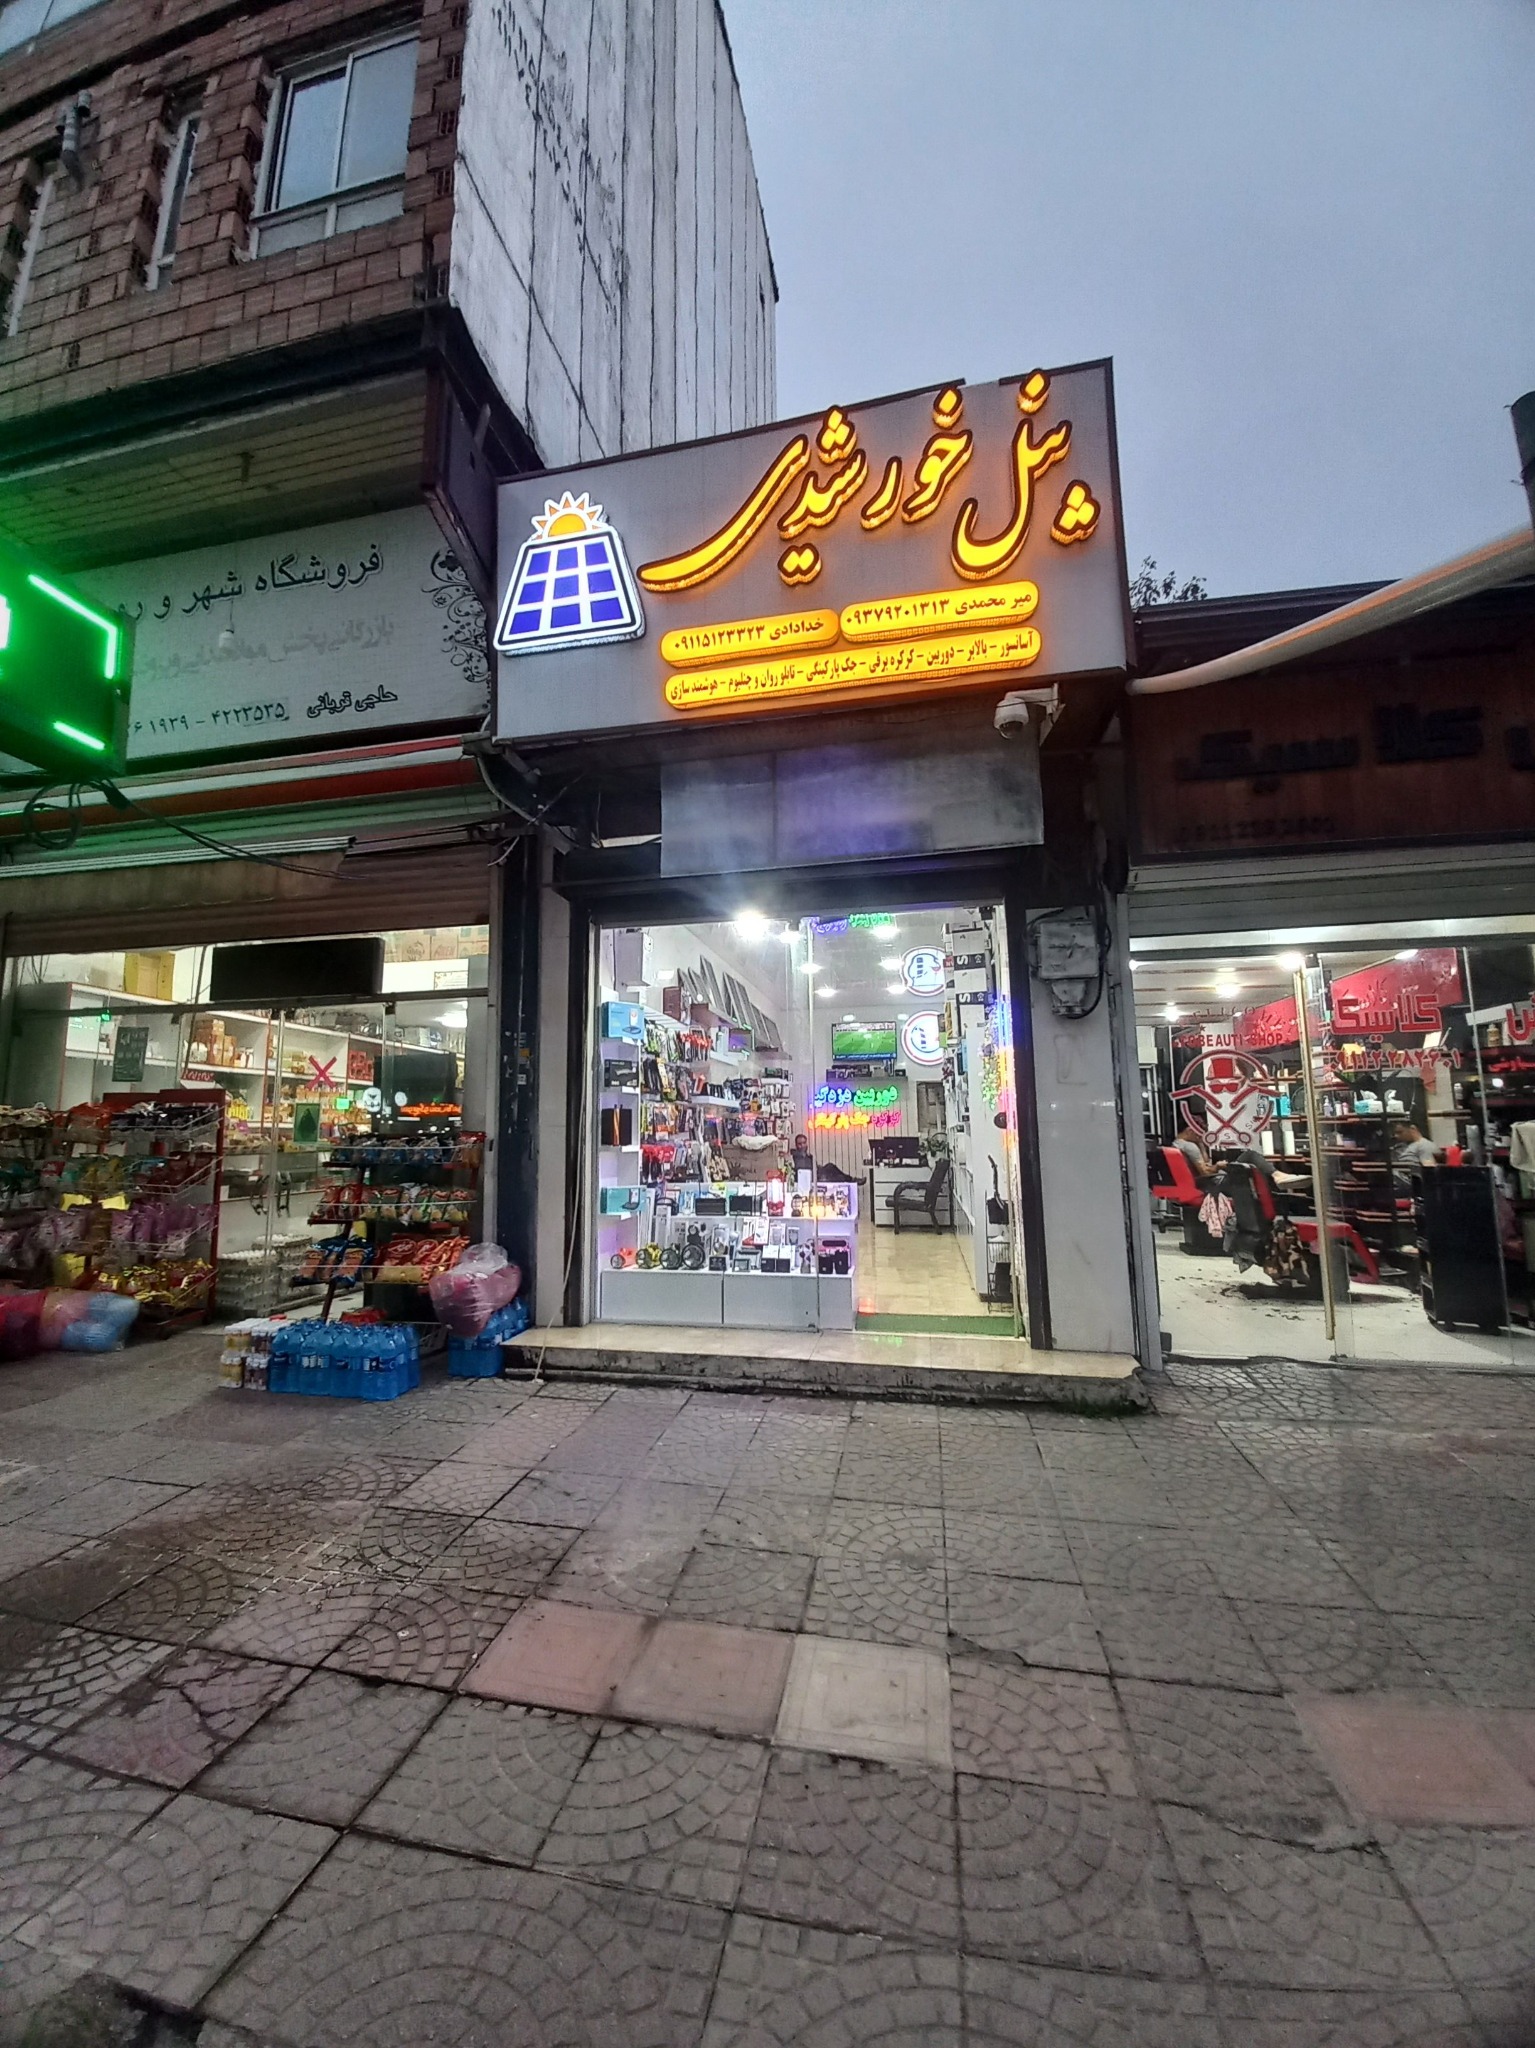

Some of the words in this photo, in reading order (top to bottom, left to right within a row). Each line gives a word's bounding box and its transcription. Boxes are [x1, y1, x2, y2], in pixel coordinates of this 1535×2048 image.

[952, 370, 1101, 579] پنل
[637, 387, 973, 593] خورشیدی
[255, 543, 383, 590] فروشگاه
[182, 570, 243, 614] شهر
[1010, 593, 1032, 609] میر
[153, 595, 171, 619] و
[955, 597, 1006, 615] محمدی
[769, 617, 824, 641] خدادادی
[967, 638, 987, 661] بالابر
[1000, 630, 1034, 657] آسانسور
